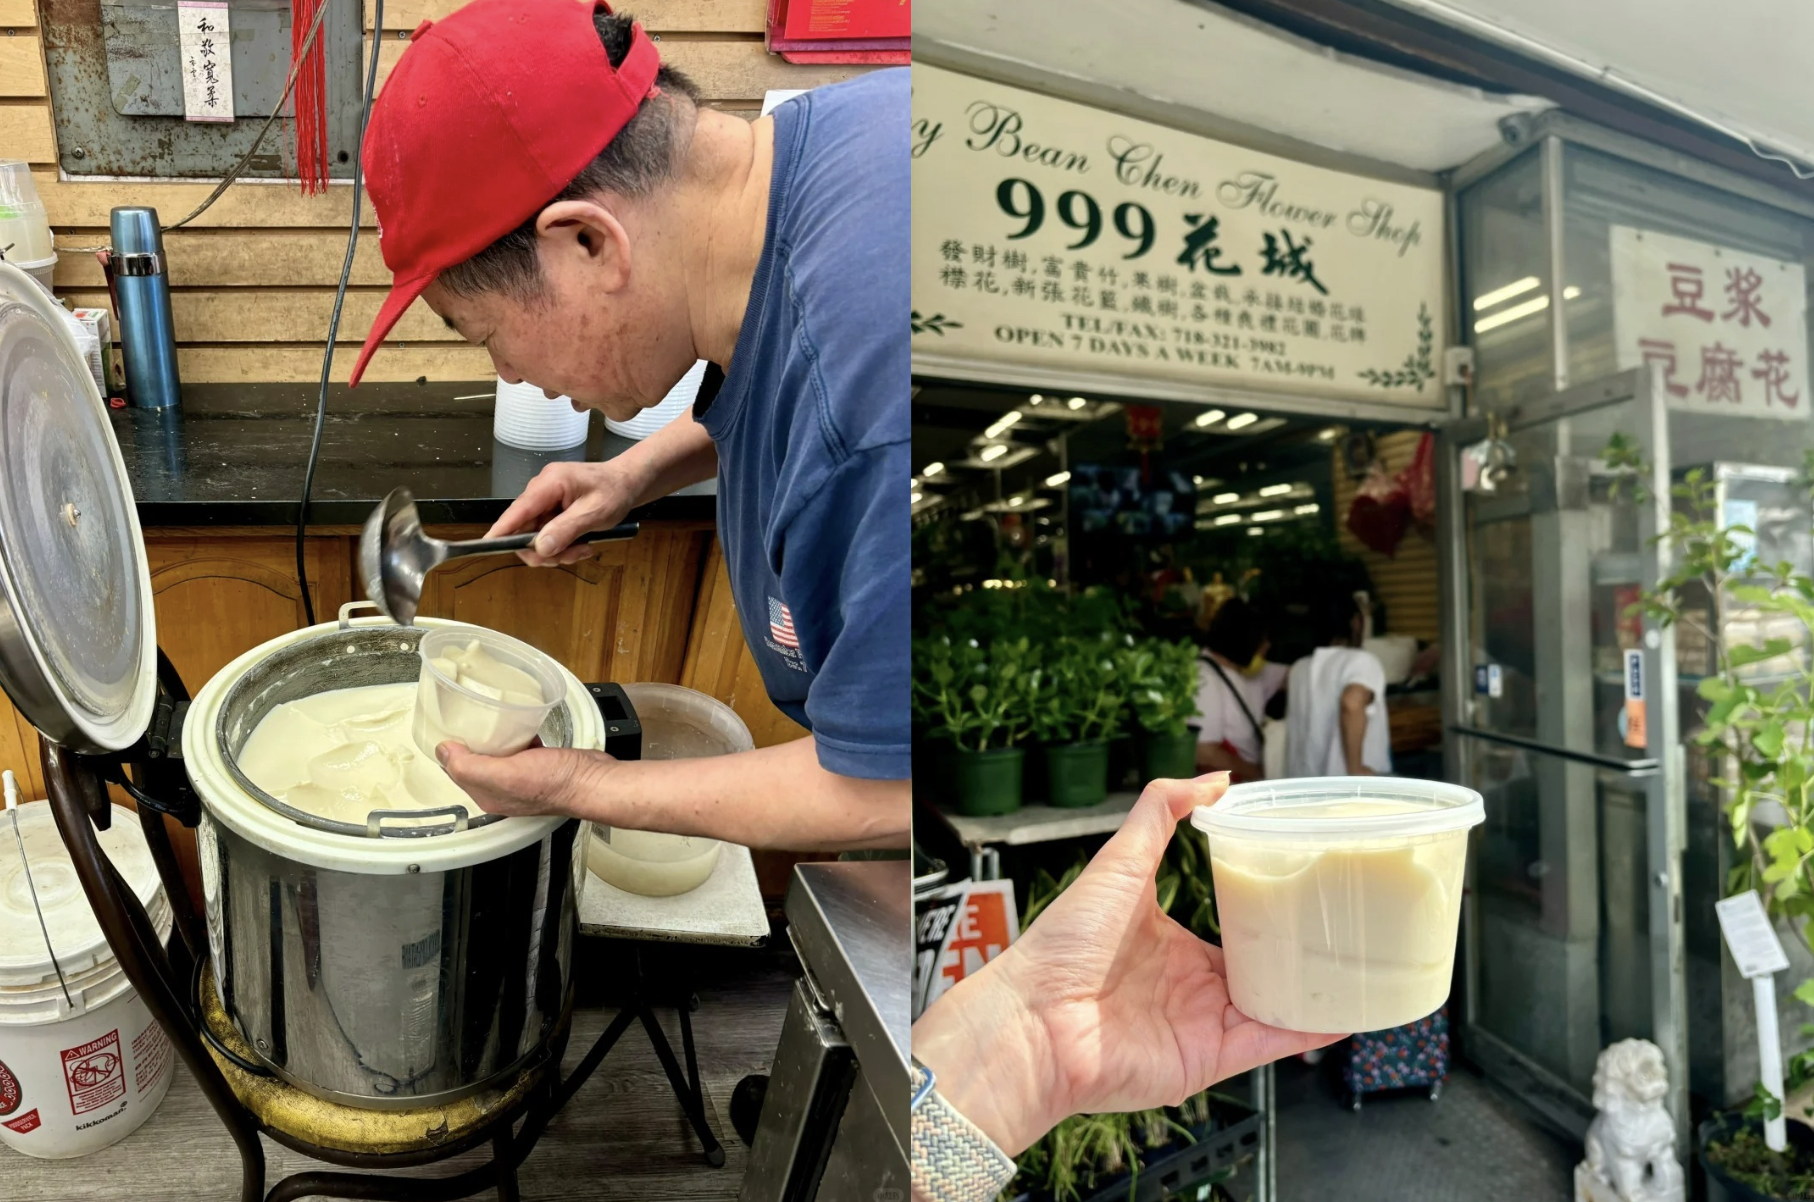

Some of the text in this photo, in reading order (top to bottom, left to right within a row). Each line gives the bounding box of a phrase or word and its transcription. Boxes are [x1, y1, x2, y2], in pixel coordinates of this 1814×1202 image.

[911, 100, 1421, 258] y Bean Chen Flower Shop
[996, 177, 1330, 296] 999 花城
[1661, 262, 1772, 329] 豆浆
[994, 324, 1064, 348] OPEN
[1071, 335, 1084, 350] 7
[1089, 336, 1149, 358] DAYS
[1156, 346, 1170, 361] A
[1176, 346, 1239, 369] WEEK
[1061, 311, 1166, 341] TEL/FAX:
[79, 1032, 118, 1056] WARNING
[75, 1107, 125, 1131] kikkoman
